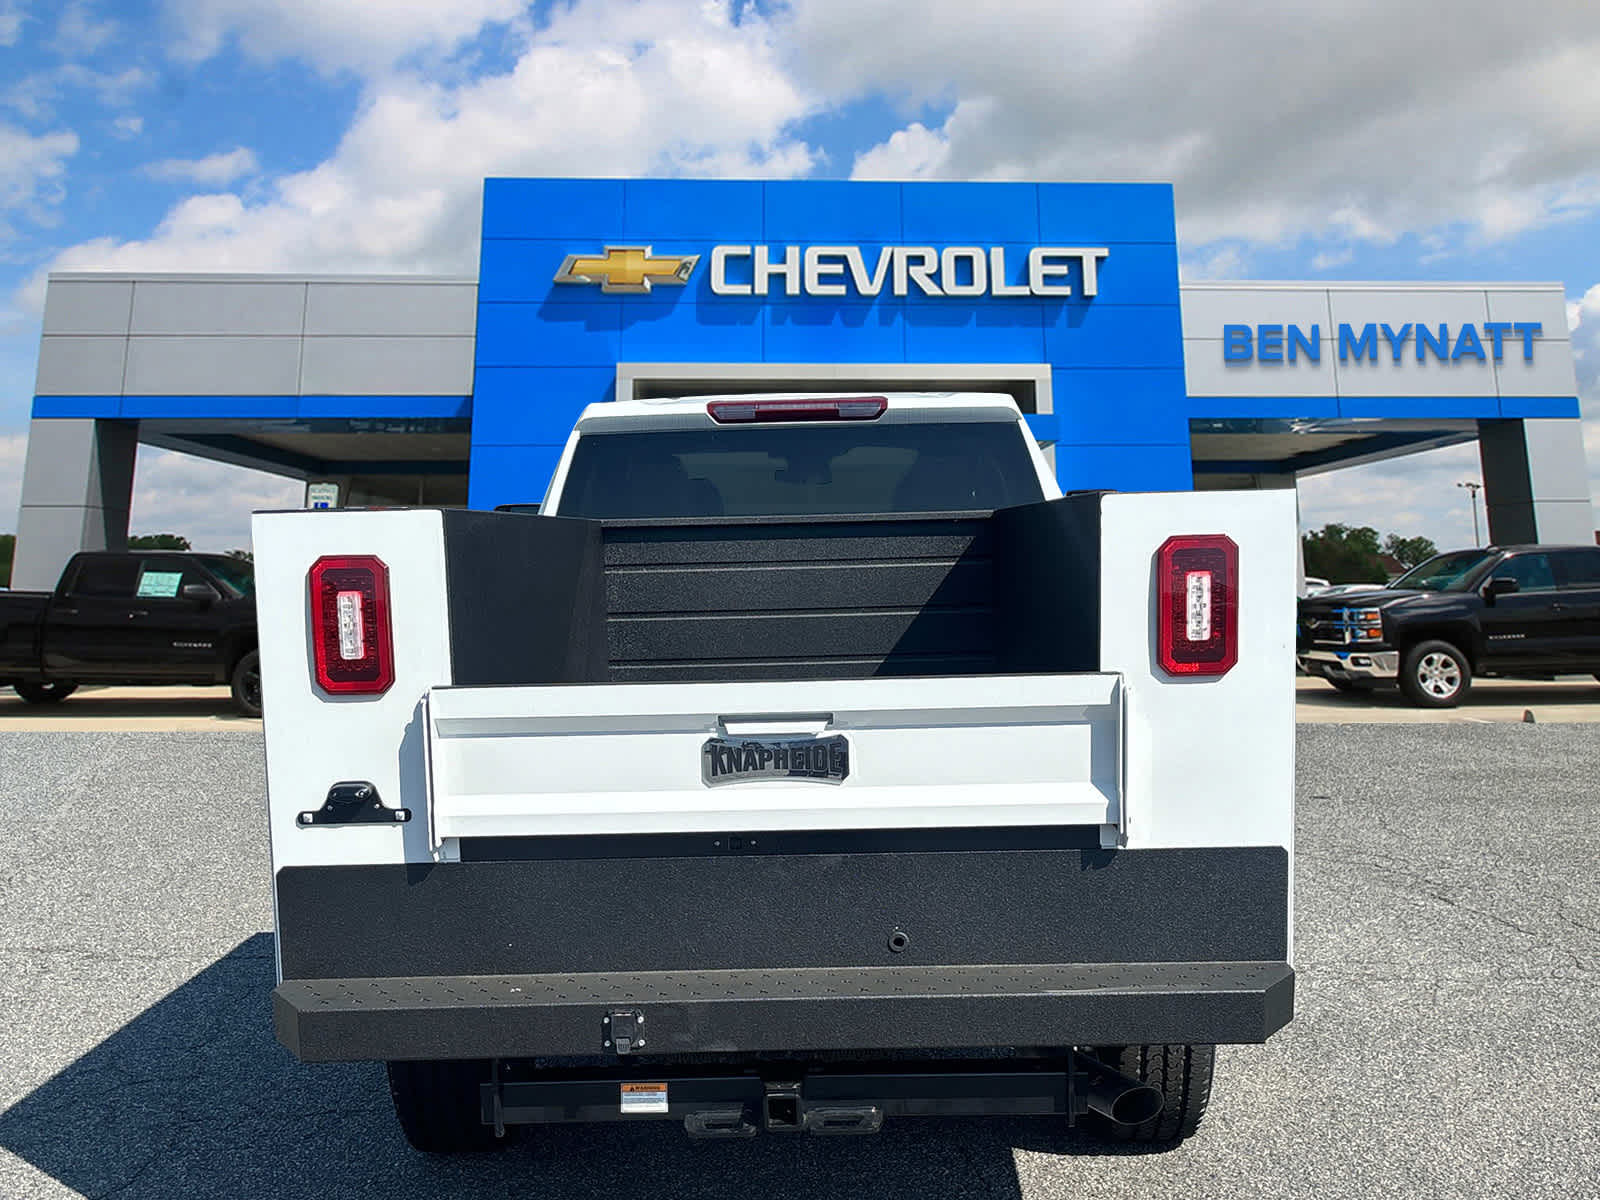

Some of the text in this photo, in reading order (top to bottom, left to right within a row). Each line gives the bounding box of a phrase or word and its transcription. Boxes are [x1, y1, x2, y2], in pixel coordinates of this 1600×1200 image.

[710, 244, 1109, 297] CHEVROLET
[1223, 321, 1543, 363] BEN MYNATT
[710, 742, 844, 777] KNAPHEIDE
